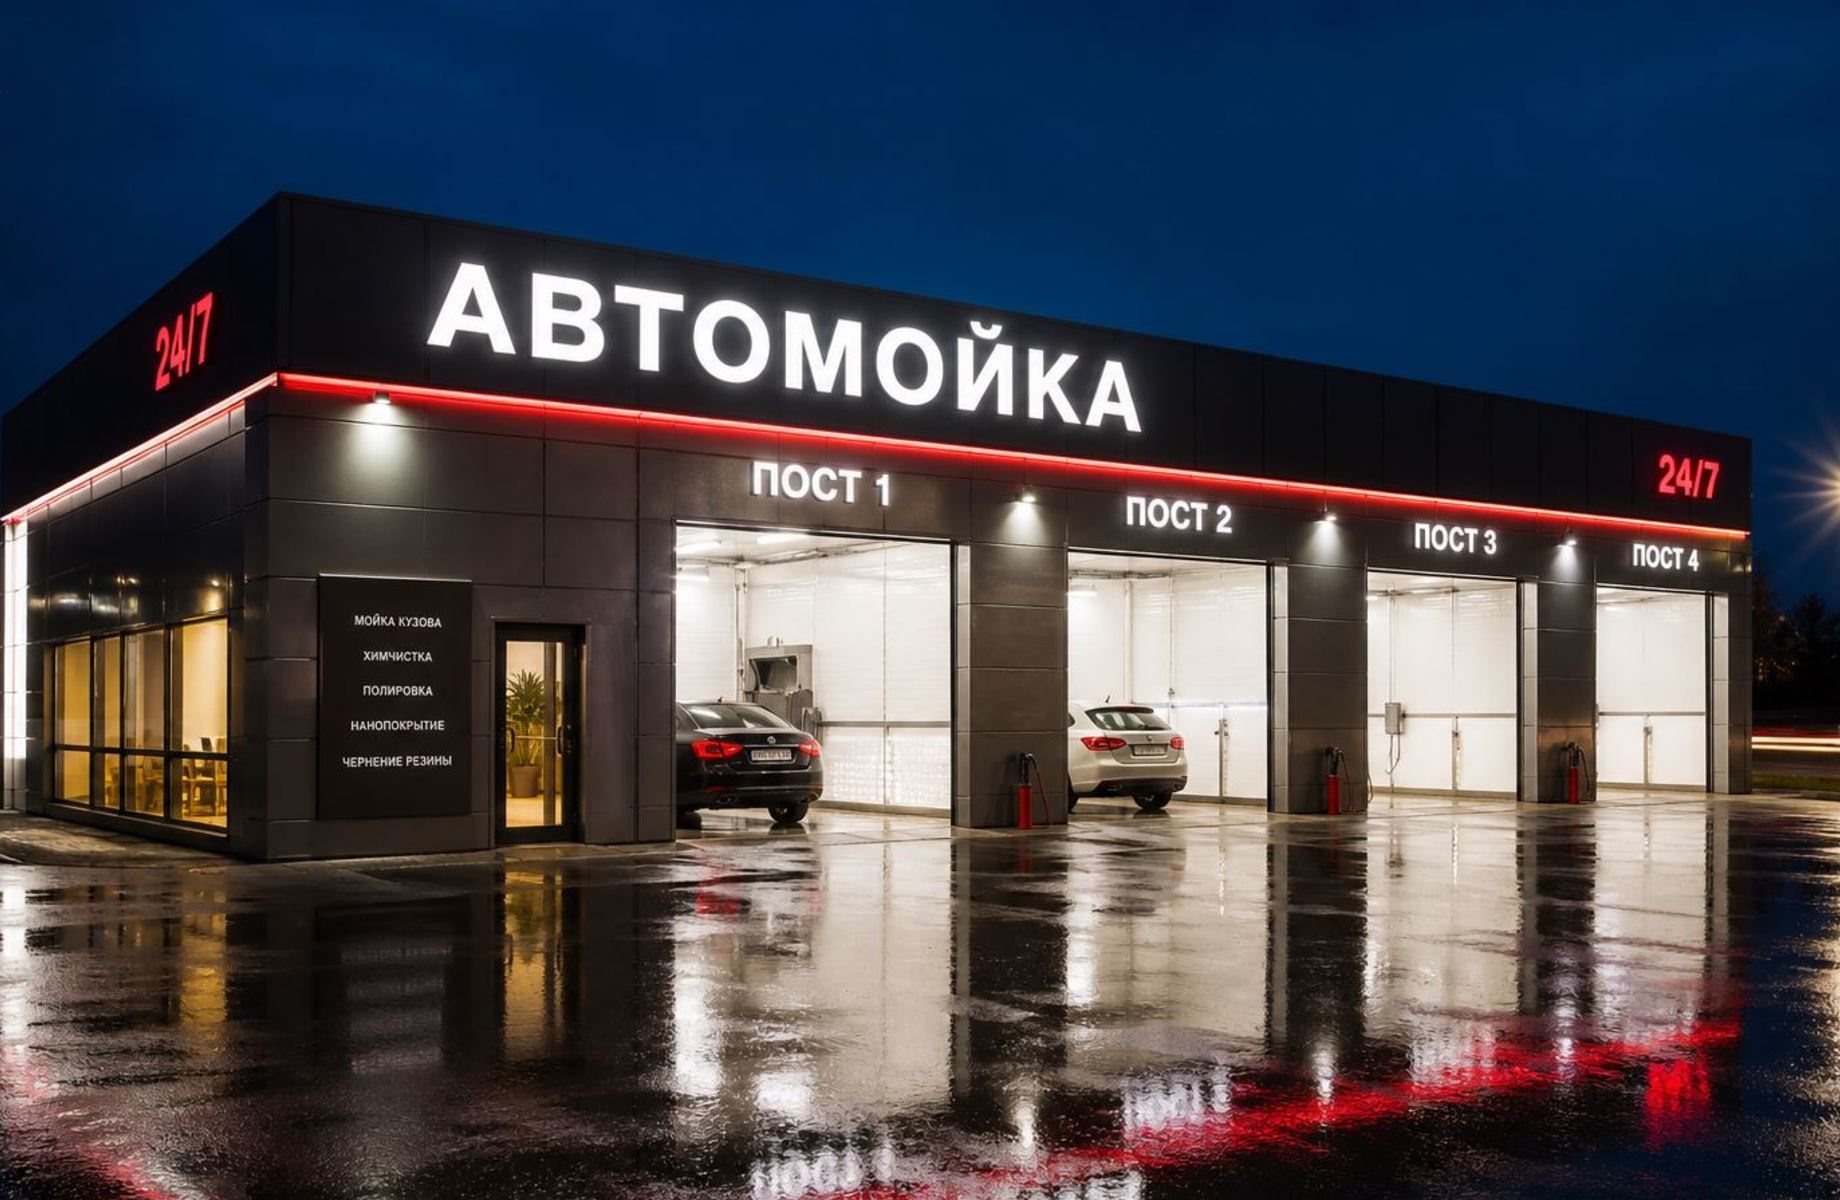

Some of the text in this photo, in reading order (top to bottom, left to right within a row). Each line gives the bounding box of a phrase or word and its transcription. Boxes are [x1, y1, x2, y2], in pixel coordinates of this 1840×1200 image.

[155, 292, 213, 392] 24/7
[426, 261, 1142, 434] АВТОМОЙКА
[752, 460, 891, 506] ПОСТ 1
[1658, 454, 1720, 500] 24/7
[1126, 495, 1234, 535] ПОСТ 2
[1414, 522, 1498, 556] ПОСТ 3
[1632, 543, 1700, 572] ПОСТ 4
[354, 613, 442, 628] МОЙКА КУЗОВА
[363, 650, 433, 662] ХИМЧИСТКА
[363, 685, 433, 696] ПОЛИРОВКА
[350, 720, 445, 731] НАНОПОКРЫТИЕ
[342, 755, 453, 768] ЧЕРНЕНИЕ РЕЗИНЫ
